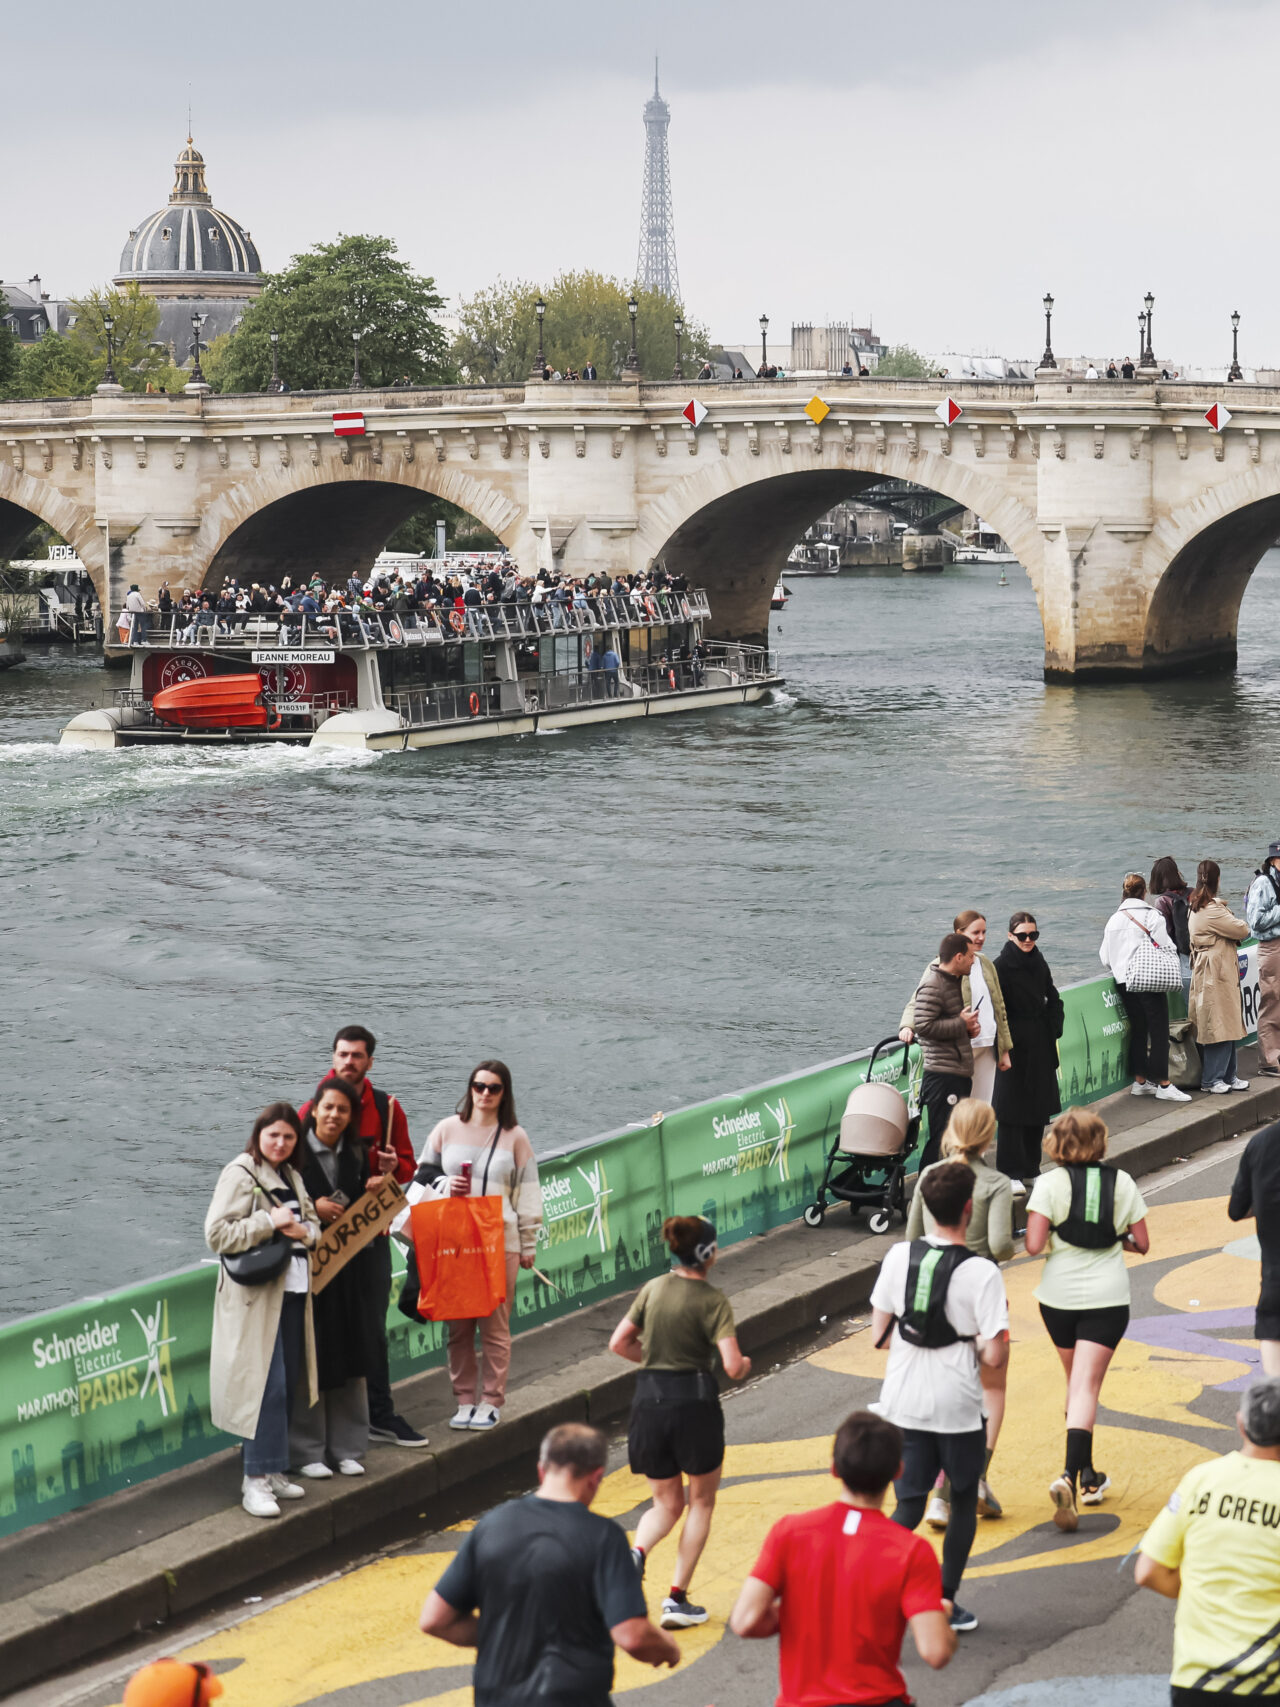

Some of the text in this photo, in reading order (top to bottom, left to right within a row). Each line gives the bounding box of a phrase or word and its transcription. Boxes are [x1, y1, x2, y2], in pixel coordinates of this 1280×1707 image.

[256, 652, 330, 662] JEANNE MOREAU
[712, 1108, 760, 1139] Schneider
[737, 1130, 765, 1147] Electric
[702, 1154, 738, 1176] MARATHON
[738, 1143, 772, 1176] PARIS
[544, 1196, 578, 1217] Electric
[549, 1210, 587, 1248] PARIS
[32, 1320, 120, 1368] Schneider
[74, 1348, 123, 1376] Electric
[17, 1366, 140, 1422] MARATHON DE PARIS
